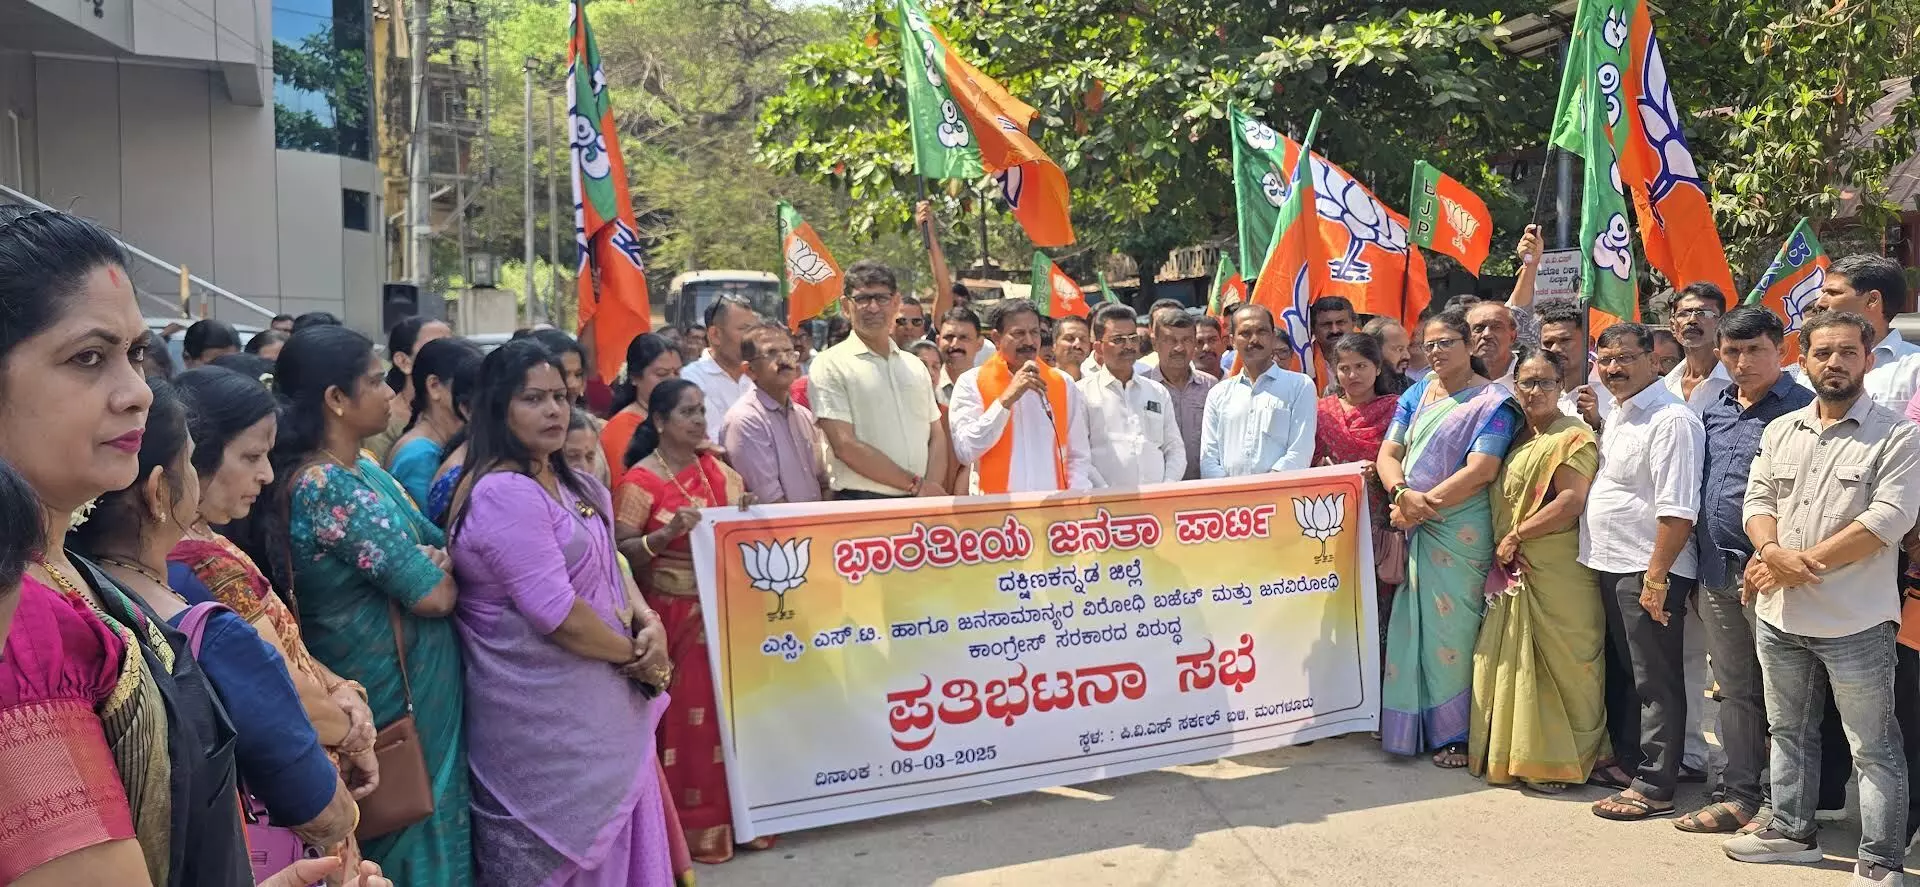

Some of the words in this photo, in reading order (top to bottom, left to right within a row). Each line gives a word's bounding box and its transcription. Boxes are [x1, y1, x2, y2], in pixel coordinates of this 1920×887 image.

[834, 514, 1033, 583] ಭಾರತೀಯ
[1048, 508, 1162, 556] ಜನತಾ
[1175, 504, 1277, 545] ಪಾರ್ಟಿ
[998, 563, 1100, 600] ದಕ್ಷಿಣಕನ್ನಡ
[1109, 559, 1143, 588] ಜಿಲ್ಲೆ
[892, 616, 949, 638] ಹಾಗೂ
[958, 602, 1074, 631] ಜನಸಾಮಾನ್ಯರ
[1083, 594, 1146, 616] ವಿರೋಧಿ
[1153, 588, 1203, 608] ಬಜೆಟ್
[1211, 582, 1253, 606] ಮತ್ತು
[1259, 573, 1340, 597] ಜನವಿರೋಧಿ
[1056, 622, 1128, 648] ಸರಕಾರದ
[1136, 616, 1183, 645] ವಿರುದ್ಧ
[886, 661, 1148, 752] ಪ್ರತಿಭಟನಾ
[1175, 633, 1258, 693] ಸಭೆ
[1120, 717, 1171, 739] ಪಿ.ವಿ.ಎಸ್
[1178, 710, 1220, 730] ಸರ್ಕಲ್
[1254, 697, 1314, 718] ಮಂಗಳೂರು
[815, 763, 871, 786] ದಿನಾಂಕ
[891, 745, 997, 775] 08-03-2025
